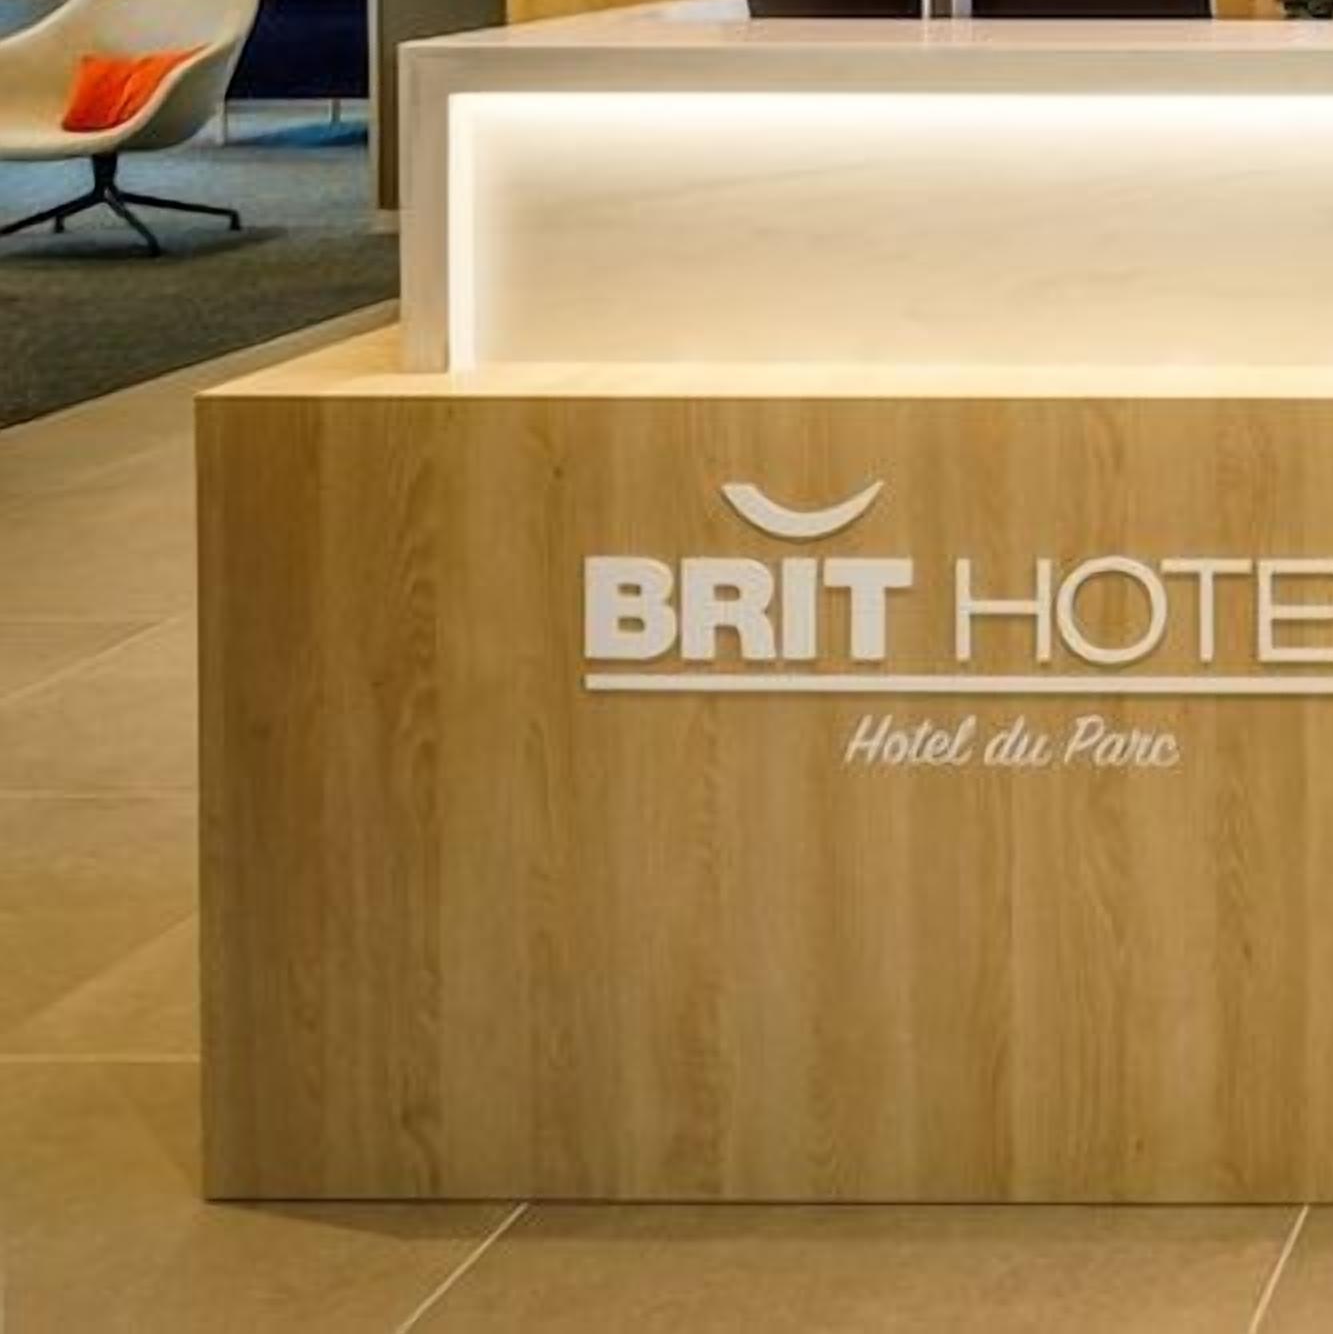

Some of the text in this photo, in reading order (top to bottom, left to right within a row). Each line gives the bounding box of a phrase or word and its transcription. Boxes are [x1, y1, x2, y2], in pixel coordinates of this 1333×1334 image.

[585, 556, 913, 662] BRIT
[844, 714, 1180, 766] Hotel du Parc
